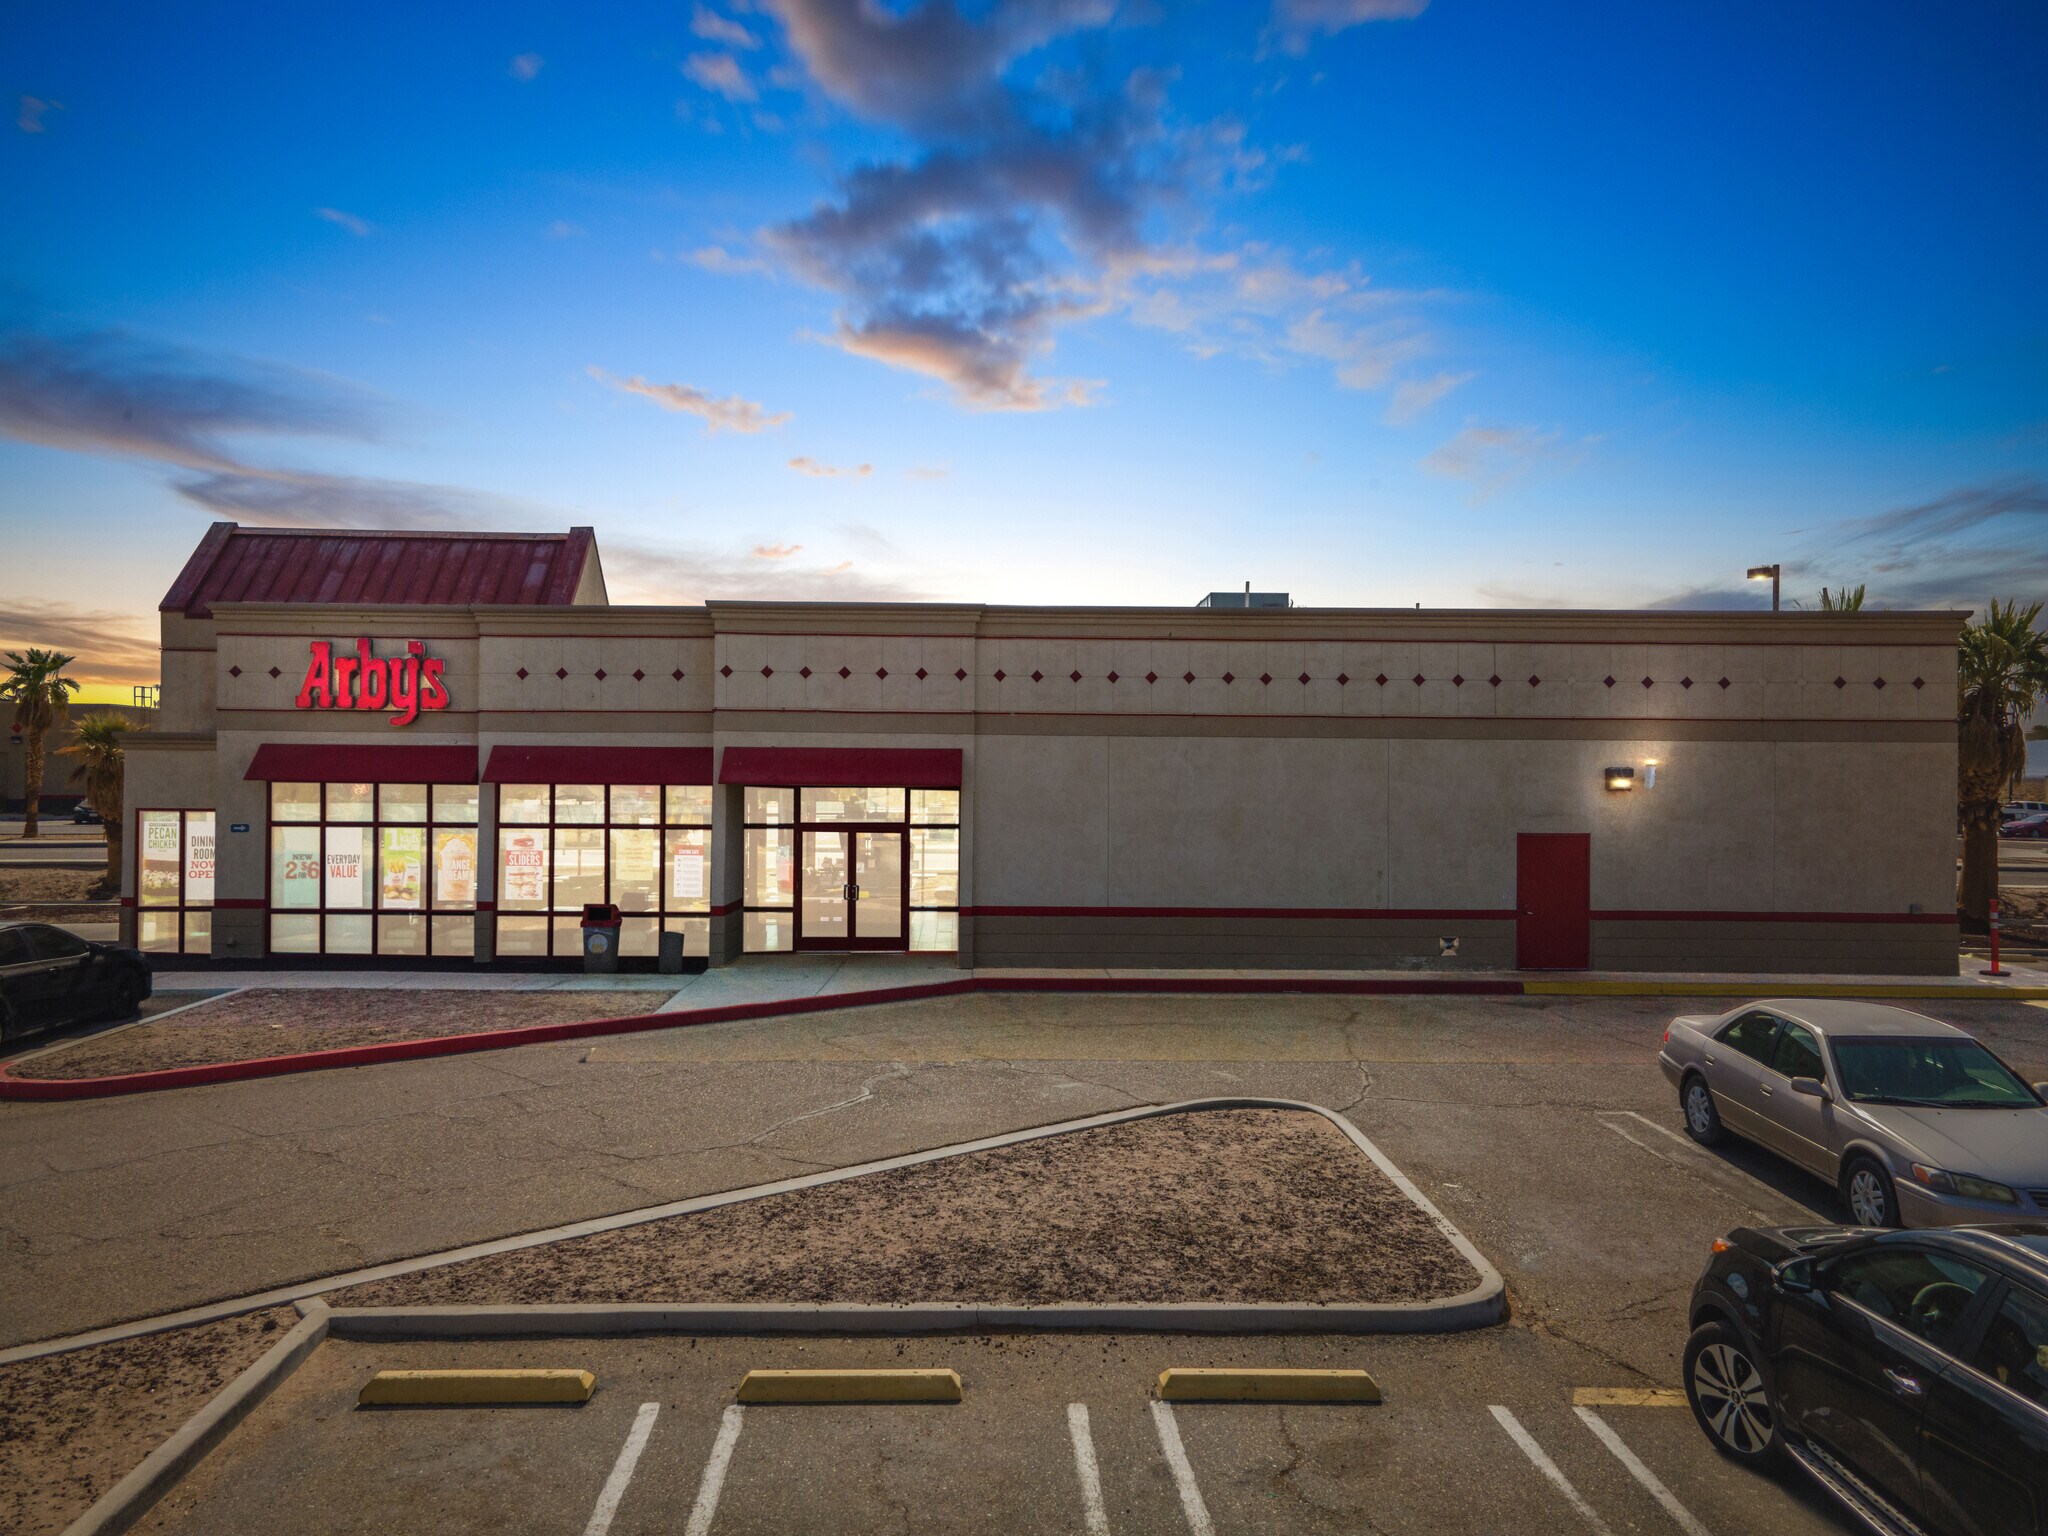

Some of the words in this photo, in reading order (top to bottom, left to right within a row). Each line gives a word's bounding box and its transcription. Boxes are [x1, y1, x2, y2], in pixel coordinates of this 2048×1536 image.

[295, 637, 449, 726] Arby's
[148, 827, 177, 840] PECAN
[148, 839, 177, 849] CHICKEN
[191, 835, 216, 847] DININ
[327, 854, 361, 865] EVERYDAY
[509, 854, 540, 866] SLIDERS
[188, 870, 216, 879] OPE
[285, 861, 298, 880] 2
[330, 865, 358, 878] VALUE
